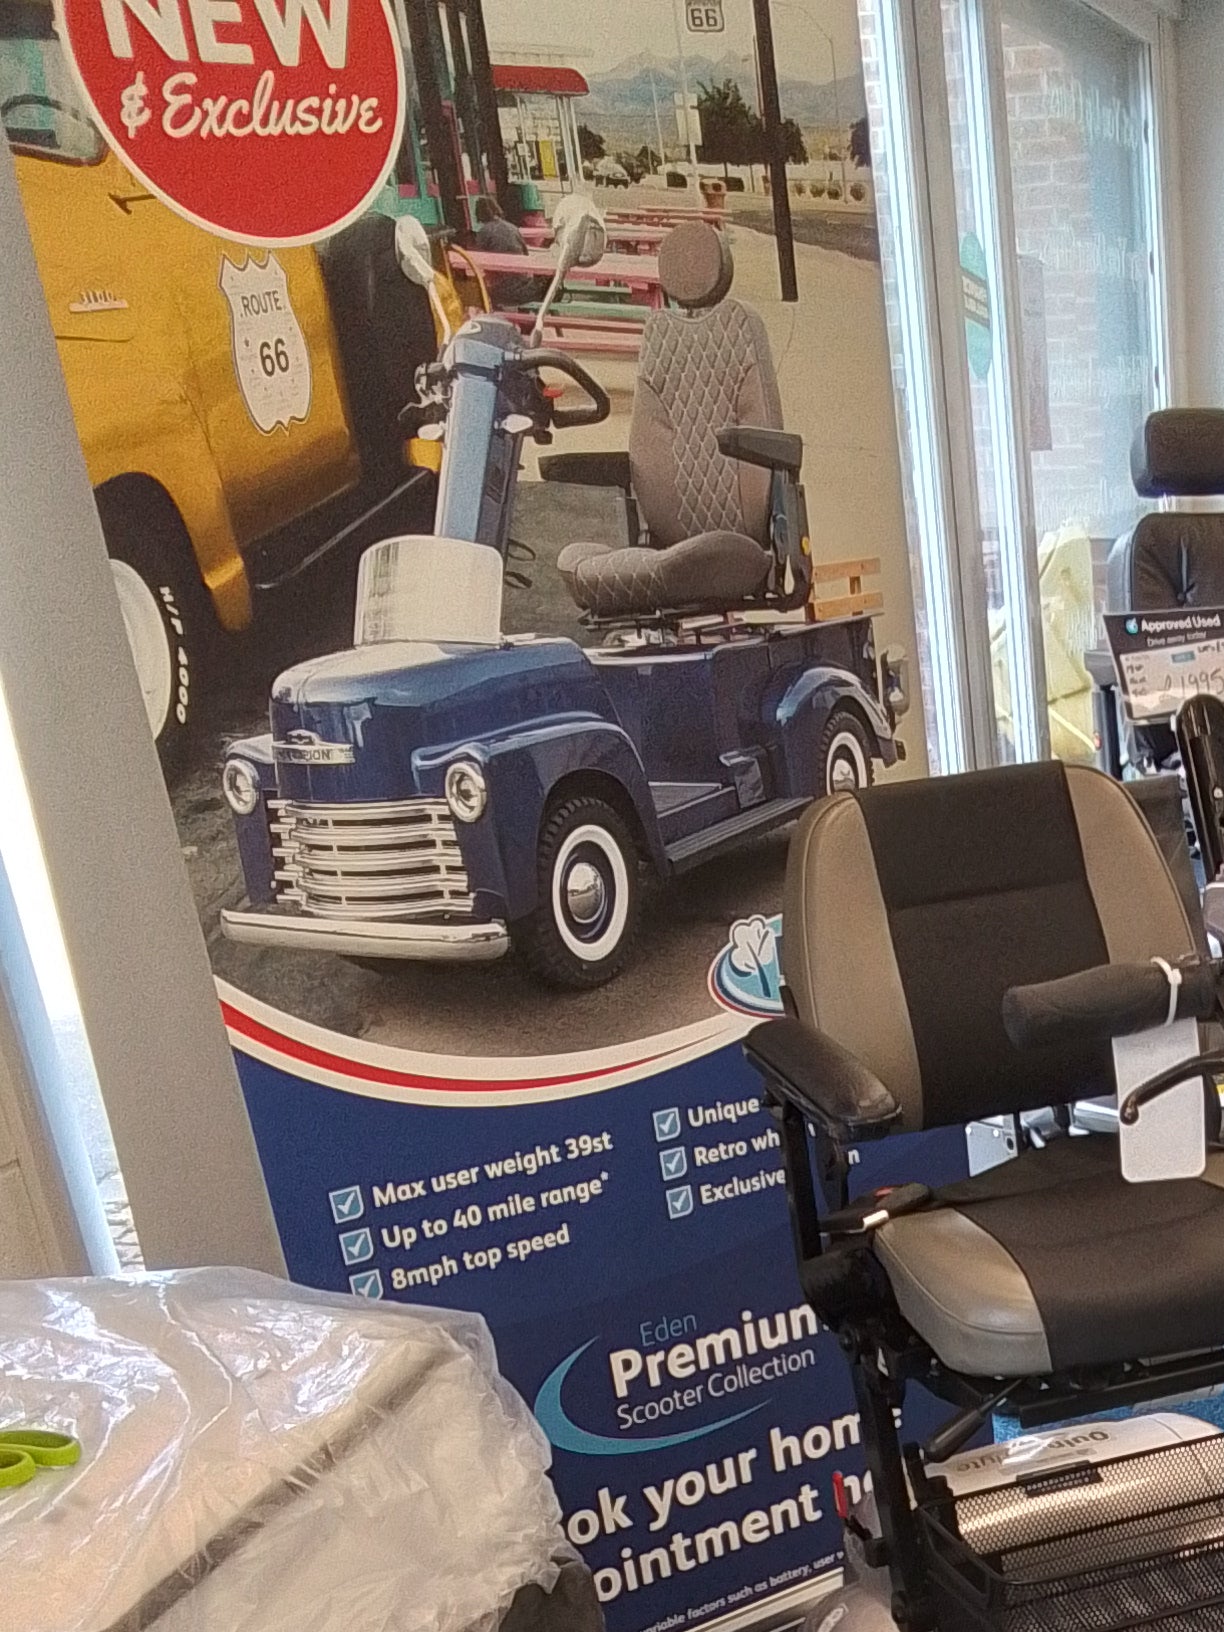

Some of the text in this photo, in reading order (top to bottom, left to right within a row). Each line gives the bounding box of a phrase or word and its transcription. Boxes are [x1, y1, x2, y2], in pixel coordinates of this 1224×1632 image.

[102, 0, 349, 68] NEW
[690, 8, 718, 28] 66
[120, 70, 383, 139] & Exclusive
[241, 290, 284, 317] ROUTE
[258, 337, 291, 377] 66
[1141, 613, 1222, 633] Approved Used
[687, 1098, 760, 1123] Unique
[372, 1131, 614, 1208] Max user weight 39st
[693, 1141, 748, 1167] Retro
[700, 1169, 786, 1205] Exclusive
[381, 1225, 418, 1251] Up
[421, 1218, 448, 1238] to
[453, 1203, 483, 1229] 40
[486, 1193, 537, 1223] mile
[391, 1222, 570, 1292] 8mph top speed
[639, 1313, 697, 1347] Eden
[616, 1349, 816, 1430] Scooter Collection
[560, 1487, 634, 1545] ok
[642, 1448, 758, 1532] your
[687, 1598, 726, 1619] factors
[727, 1586, 753, 1604] such
[754, 1581, 768, 1593] as
[813, 1553, 835, 1570] user
